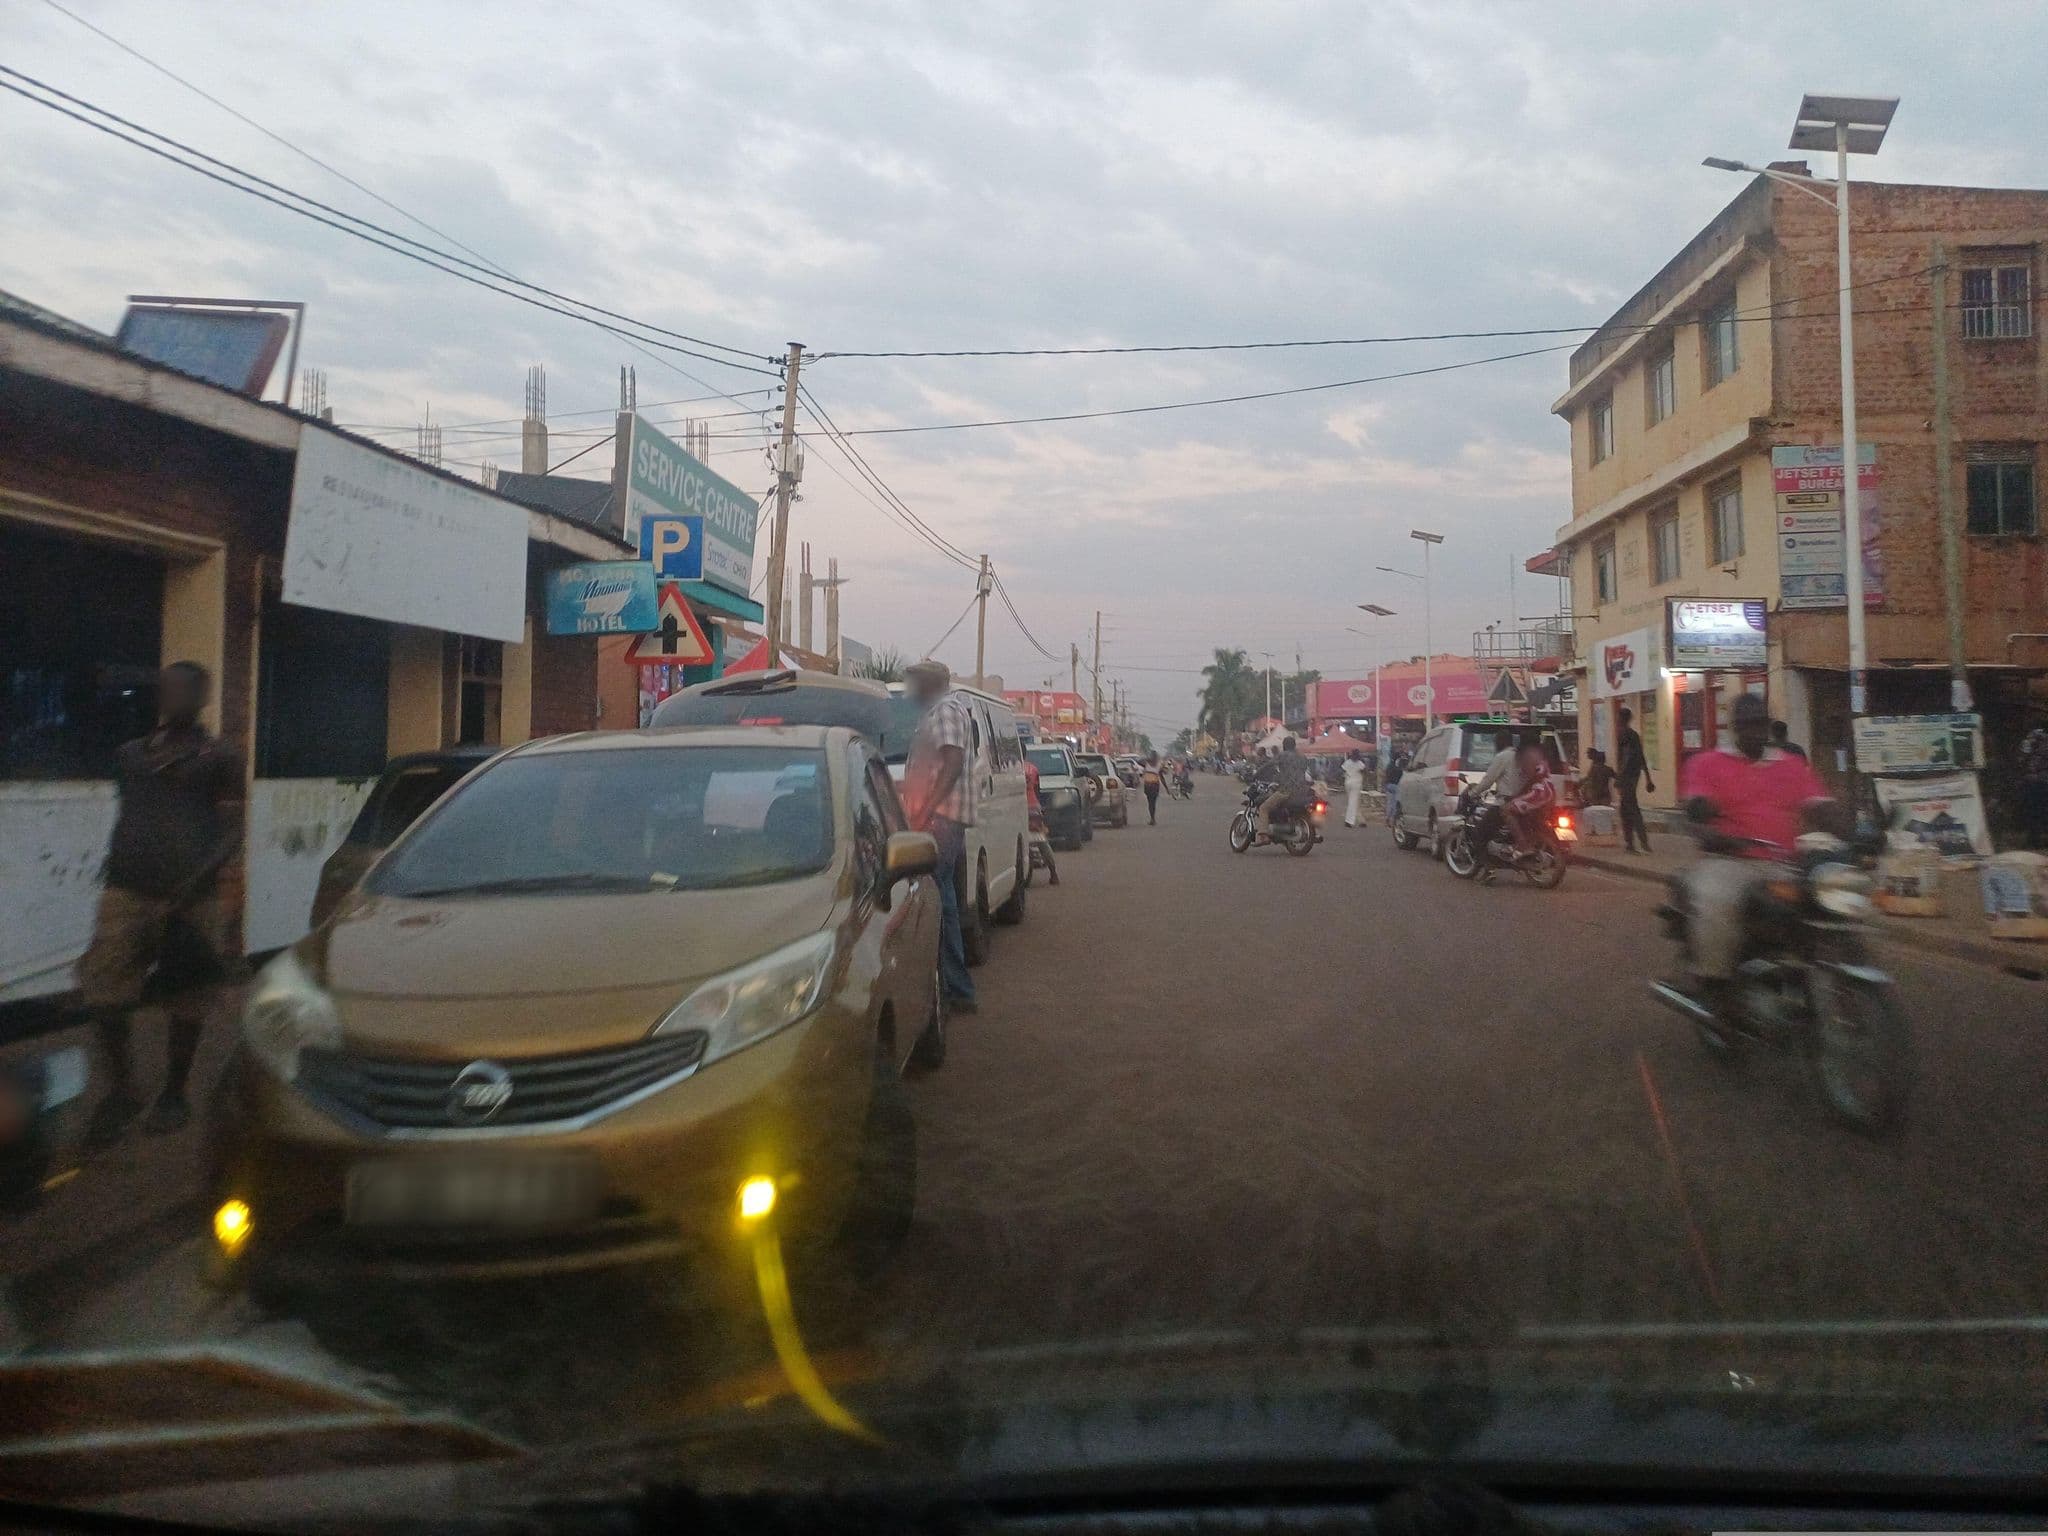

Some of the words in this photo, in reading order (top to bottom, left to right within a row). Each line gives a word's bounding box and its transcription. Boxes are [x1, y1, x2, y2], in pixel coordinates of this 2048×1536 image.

[1776, 468, 1827, 478] JETSET
[1829, 465, 1873, 477] FOEX
[1799, 479, 1844, 489] BUREA
[637, 440, 704, 512] SERVICE
[705, 487, 755, 542] CENTRE
[653, 520, 690, 573] P
